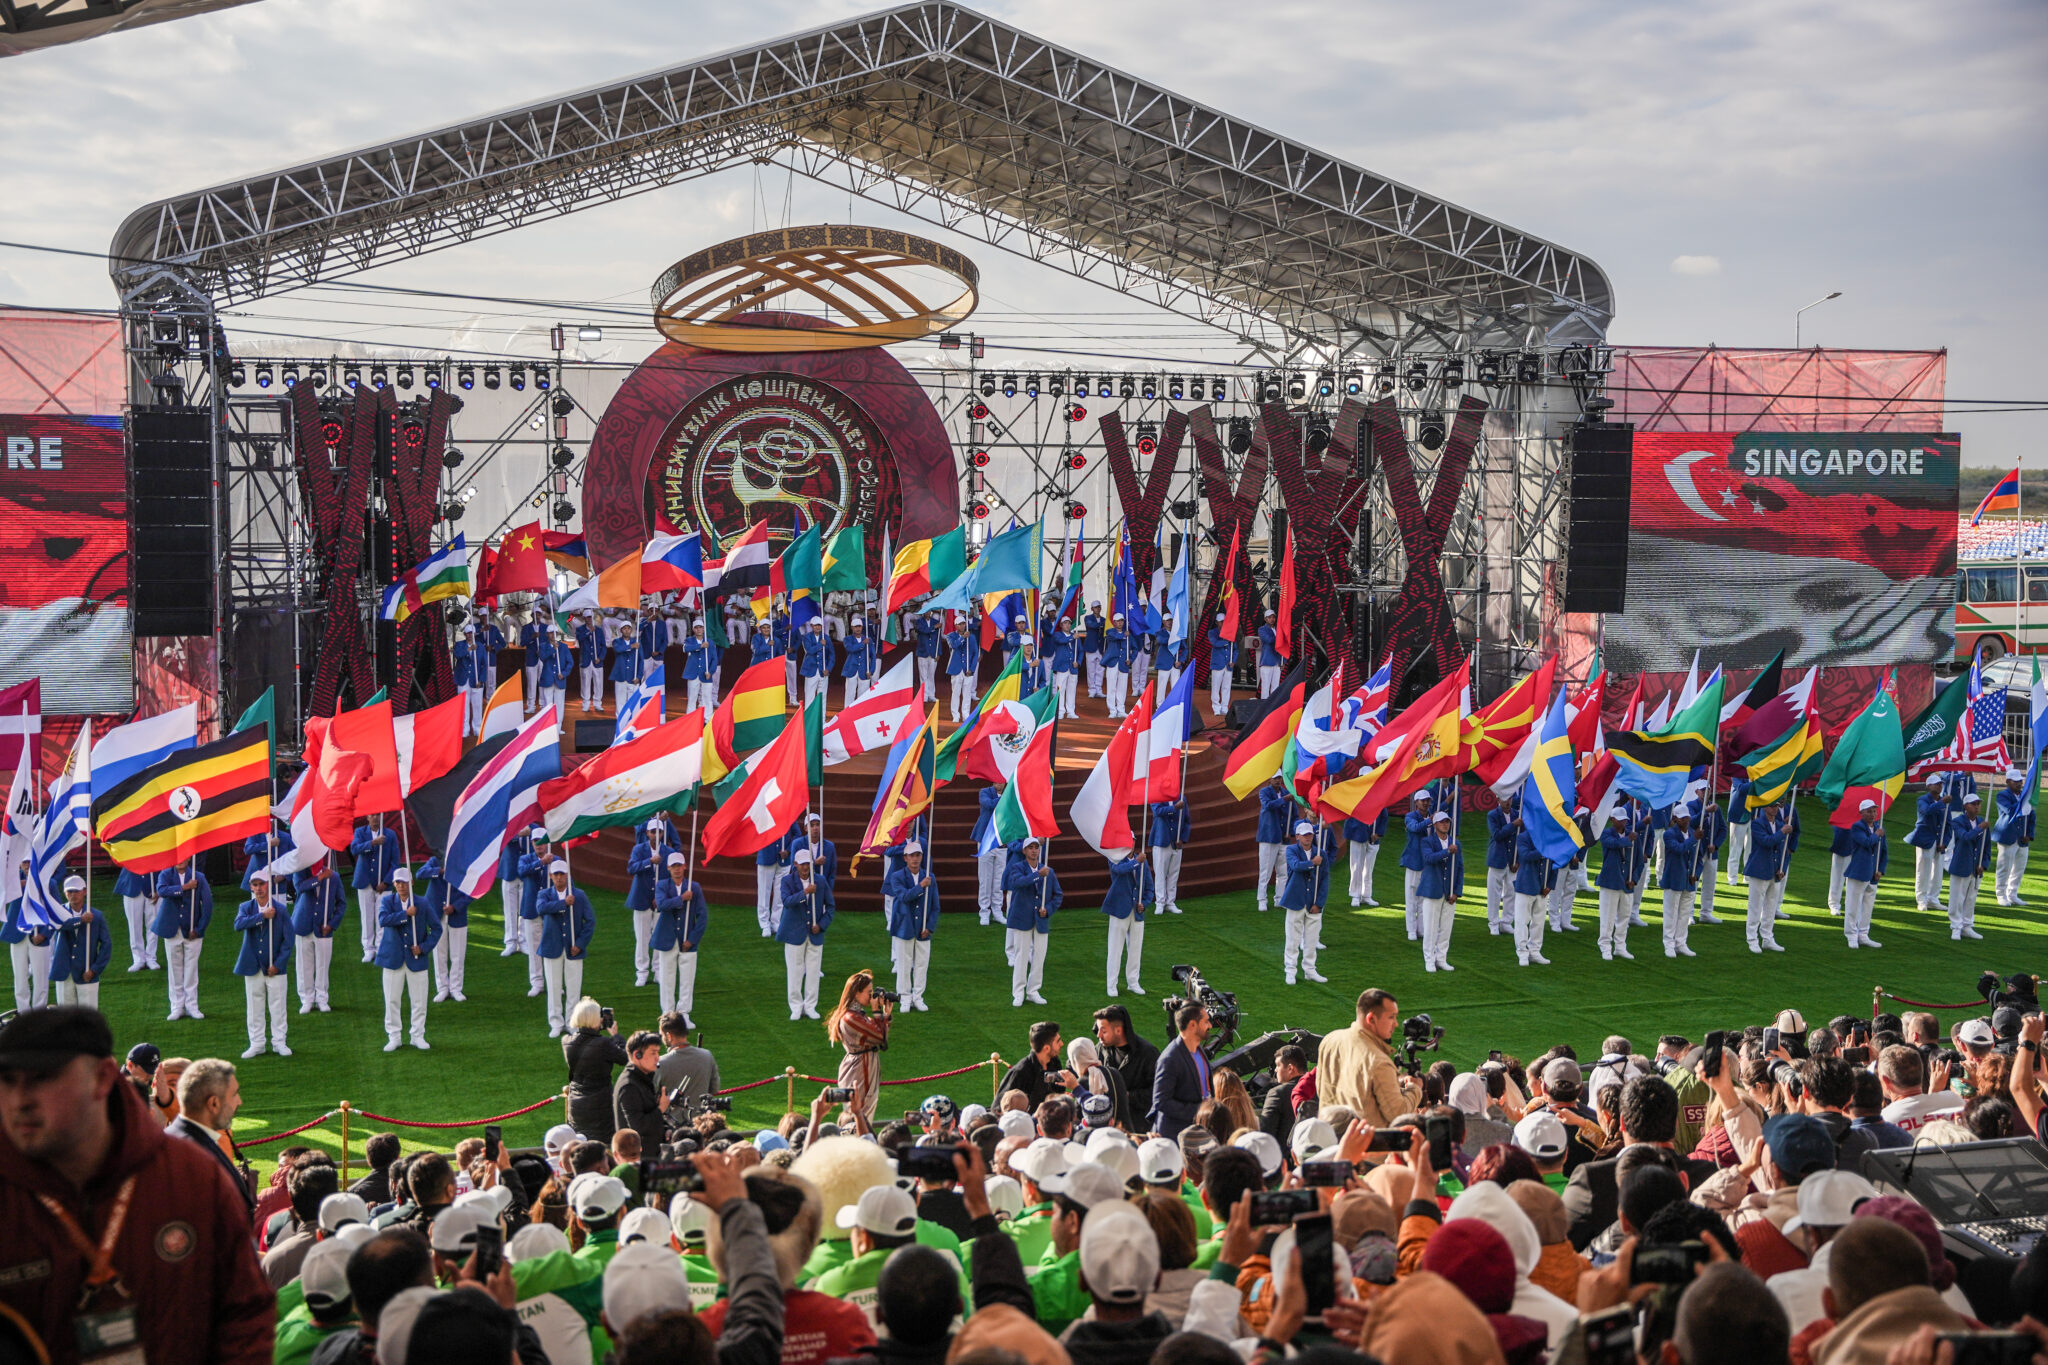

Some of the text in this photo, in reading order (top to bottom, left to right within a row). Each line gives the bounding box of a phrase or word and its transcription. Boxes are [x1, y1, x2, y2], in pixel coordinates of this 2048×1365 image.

[0, 436, 64, 470] RE
[1744, 448, 1925, 476] SINGAPORE
[518, 1300, 547, 1320] TAN
[851, 1292, 879, 1305] TUR
